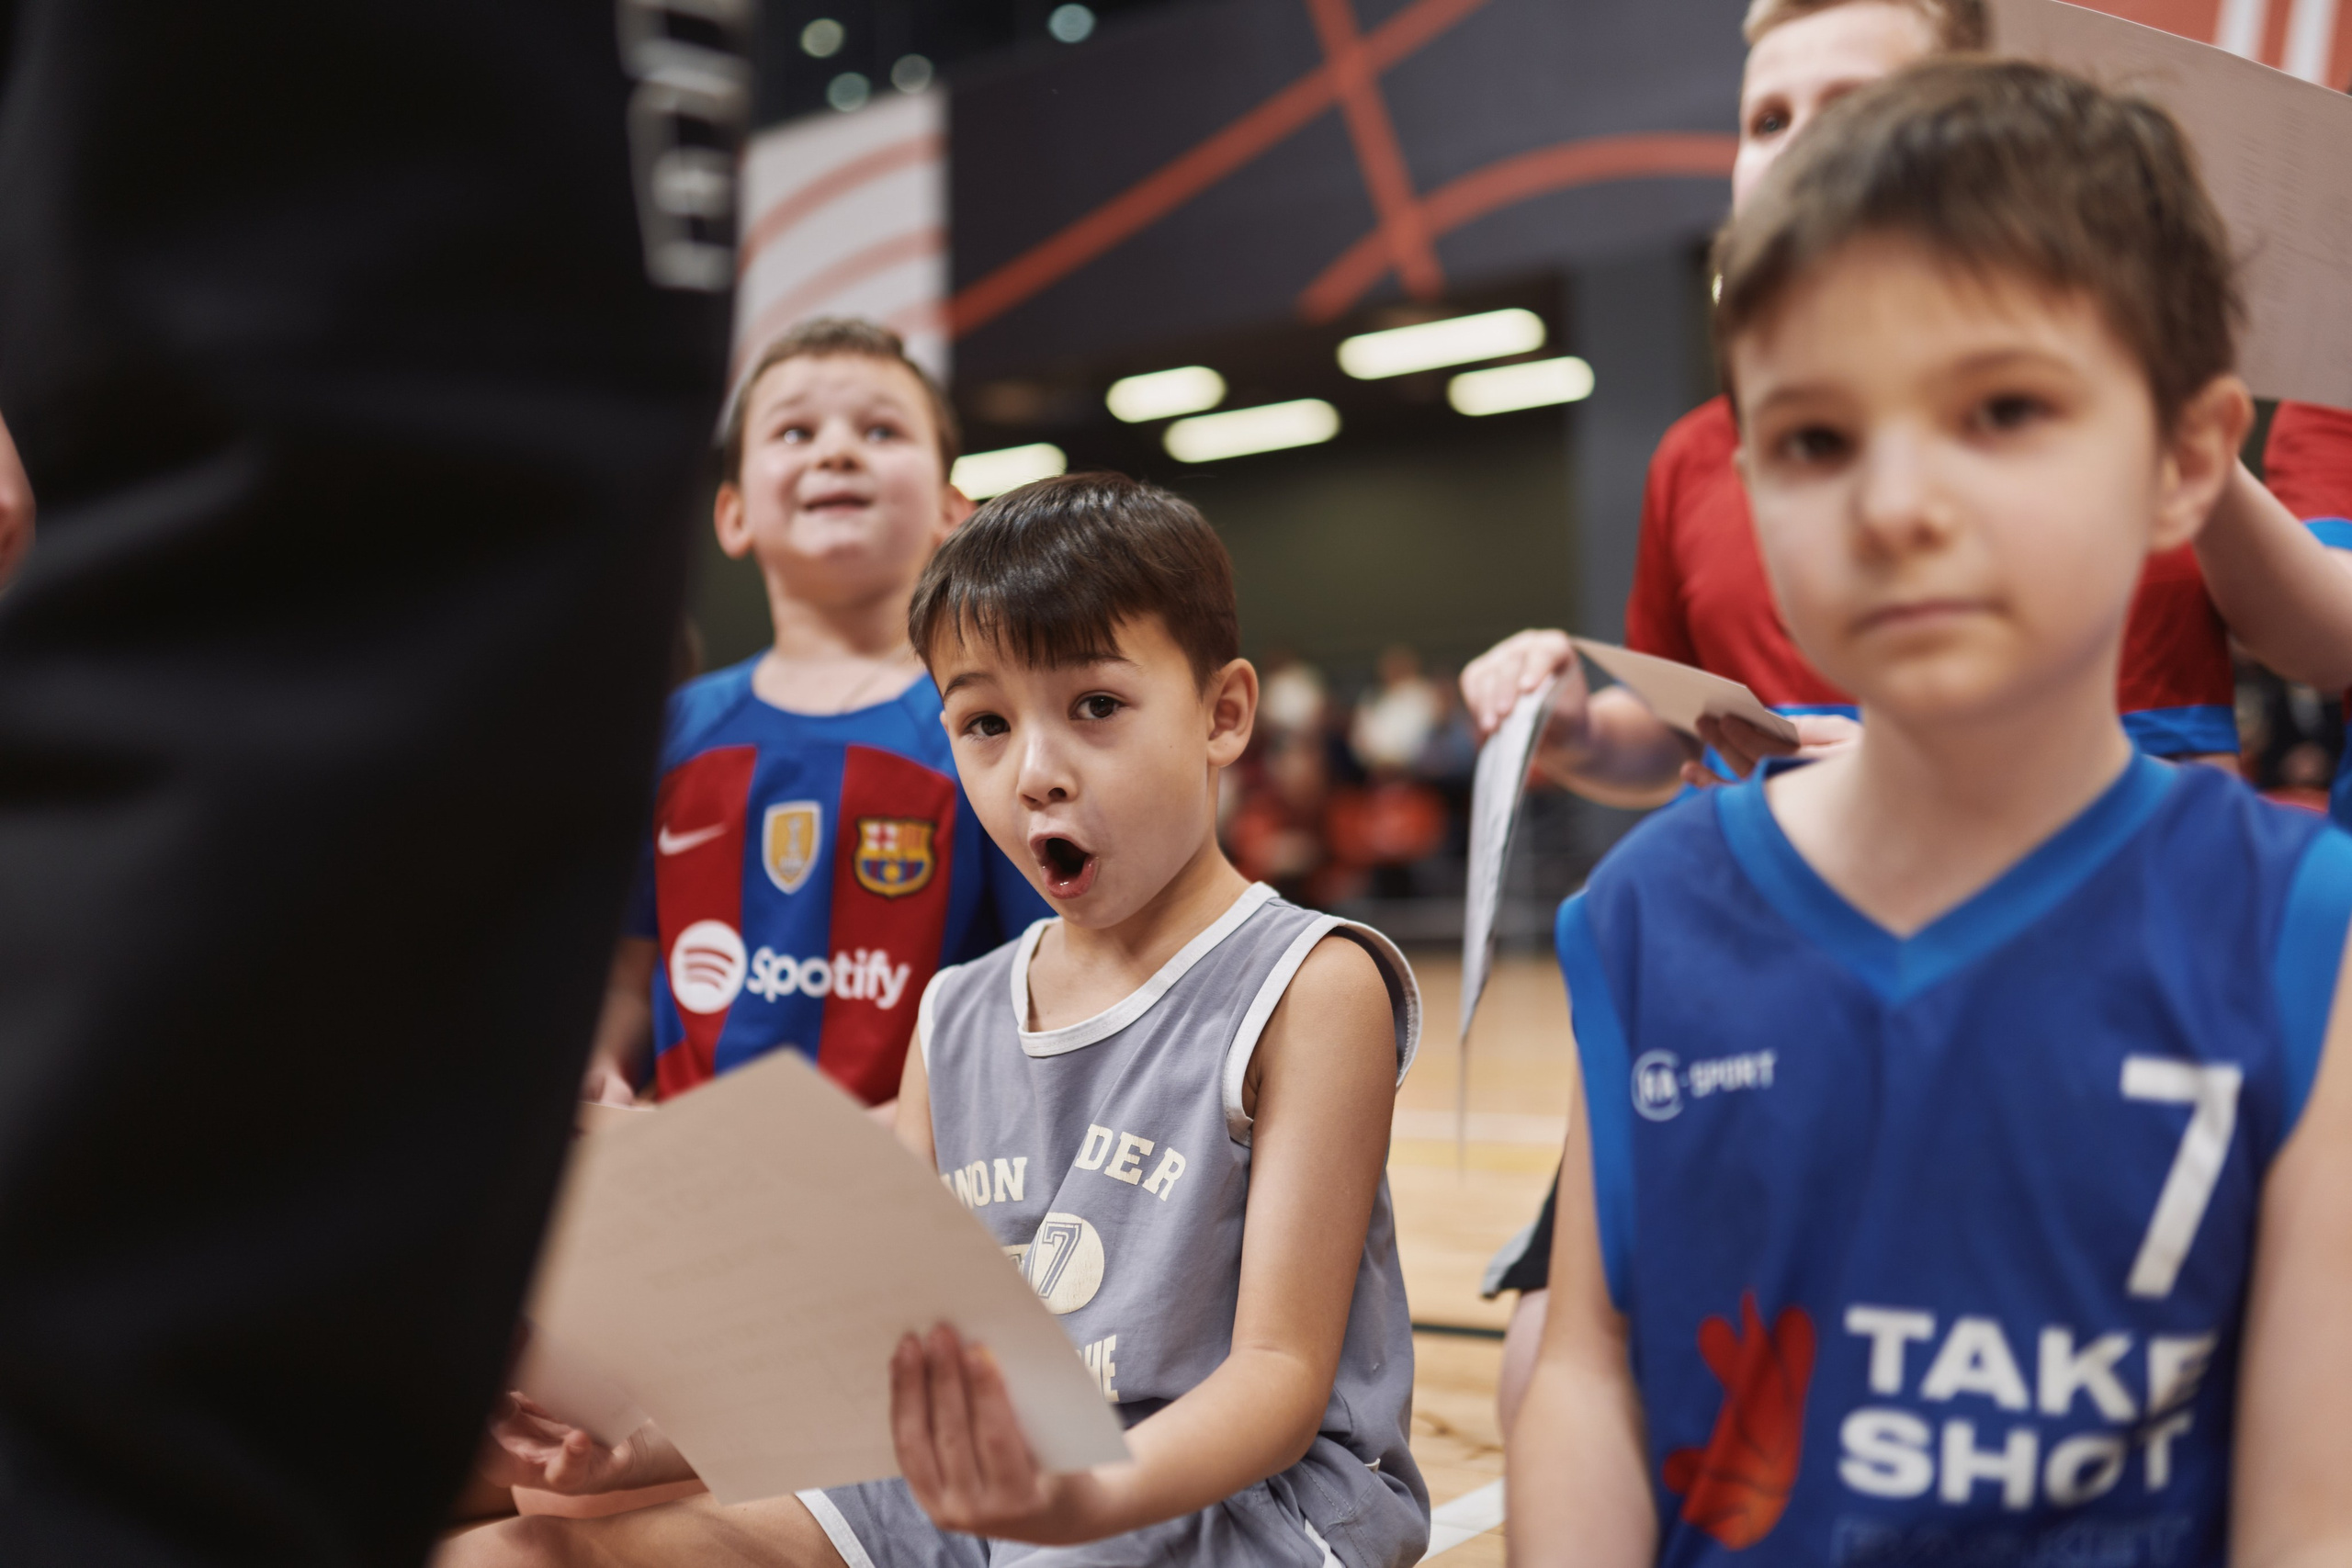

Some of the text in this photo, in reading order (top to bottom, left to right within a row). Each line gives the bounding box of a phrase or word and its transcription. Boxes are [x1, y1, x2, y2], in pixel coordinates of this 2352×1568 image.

[746, 946, 910, 1010] Spotify
[2120, 1054, 2243, 1297] 7
[1845, 1303, 2218, 1423] TAKE
[1838, 1406, 2194, 1510] SHOT
